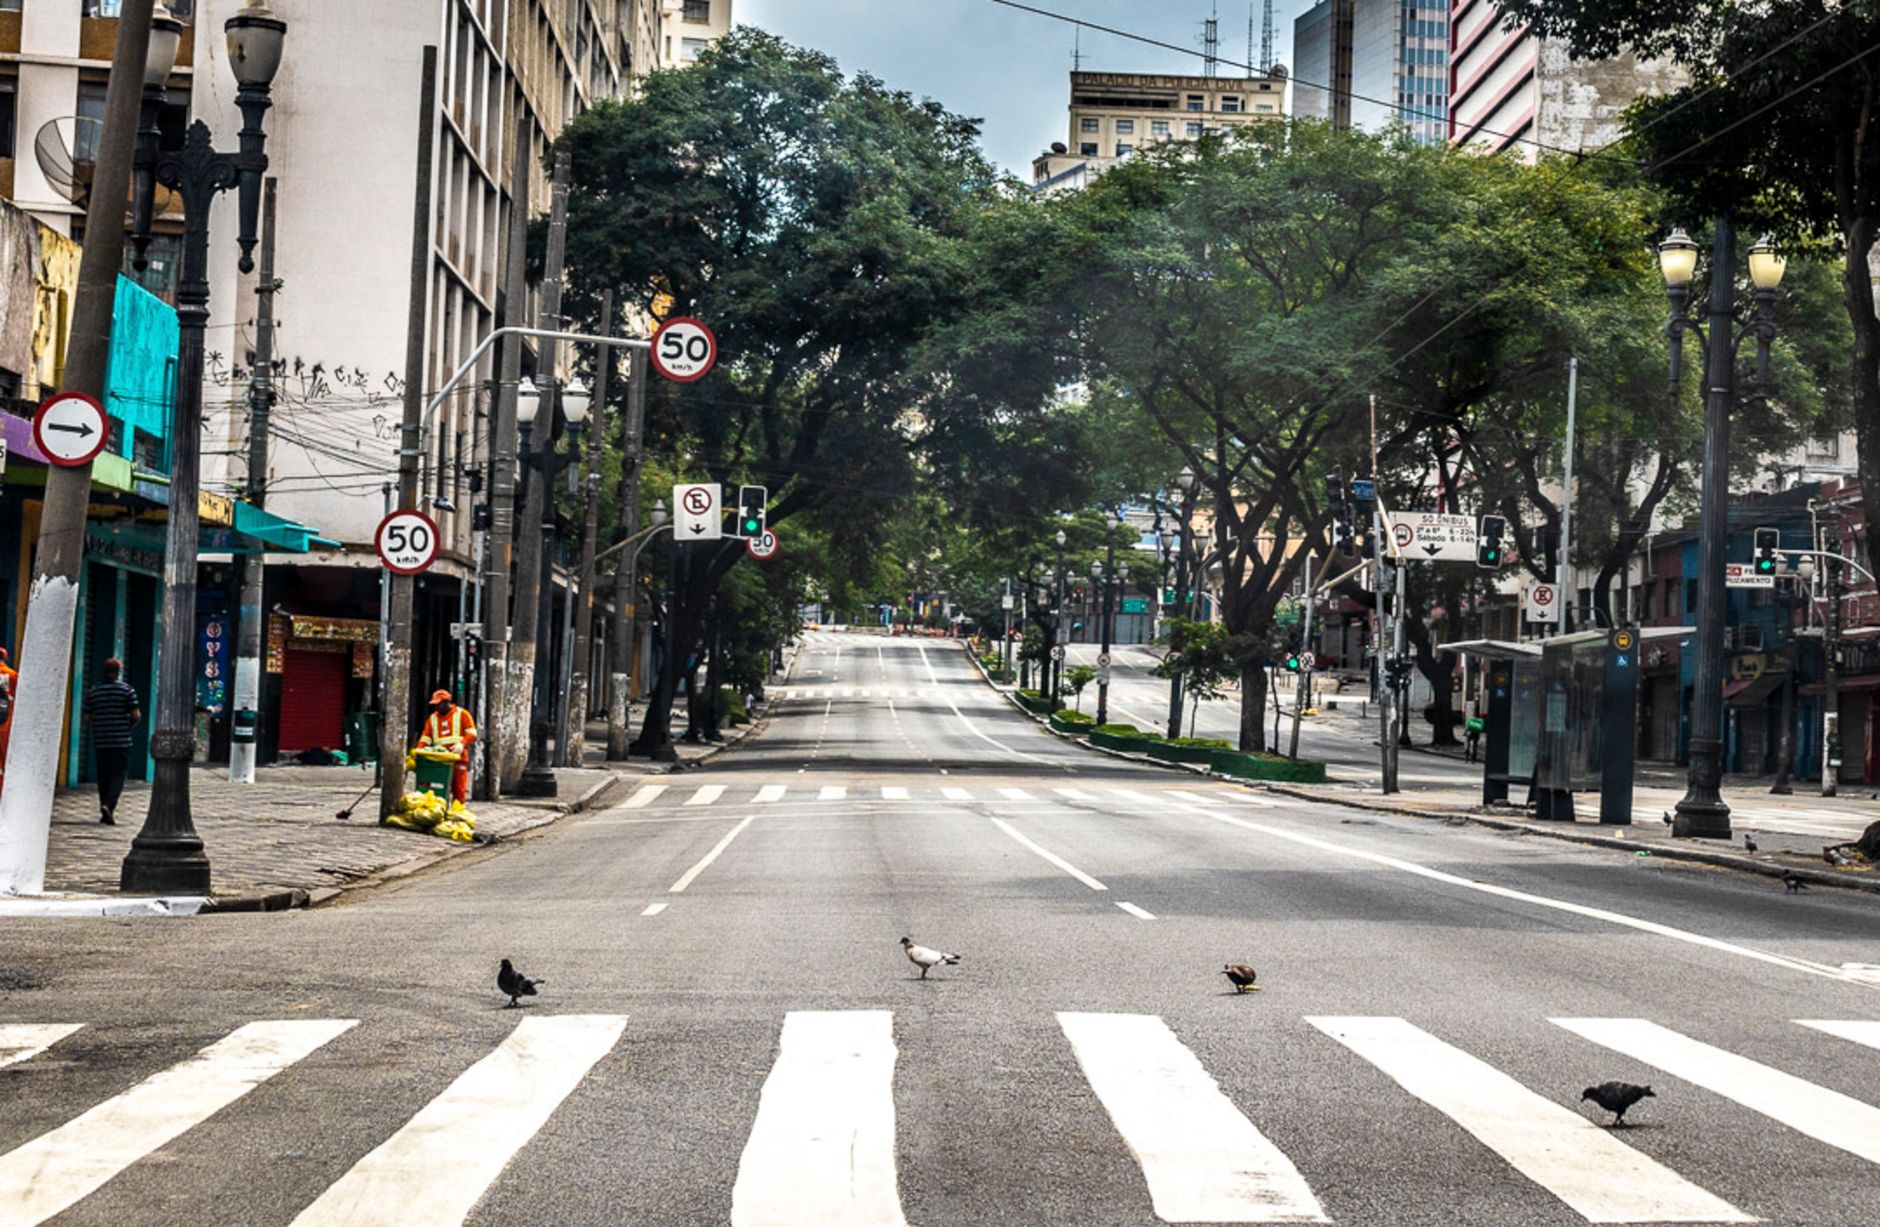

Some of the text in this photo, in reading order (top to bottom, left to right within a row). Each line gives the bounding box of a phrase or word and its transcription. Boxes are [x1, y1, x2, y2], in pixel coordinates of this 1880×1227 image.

[1139, 75, 1157, 87] DA
[661, 332, 709, 362] 50
[671, 363, 693, 371] km/h
[388, 525, 429, 552] 50
[752, 534, 774, 547] 50
